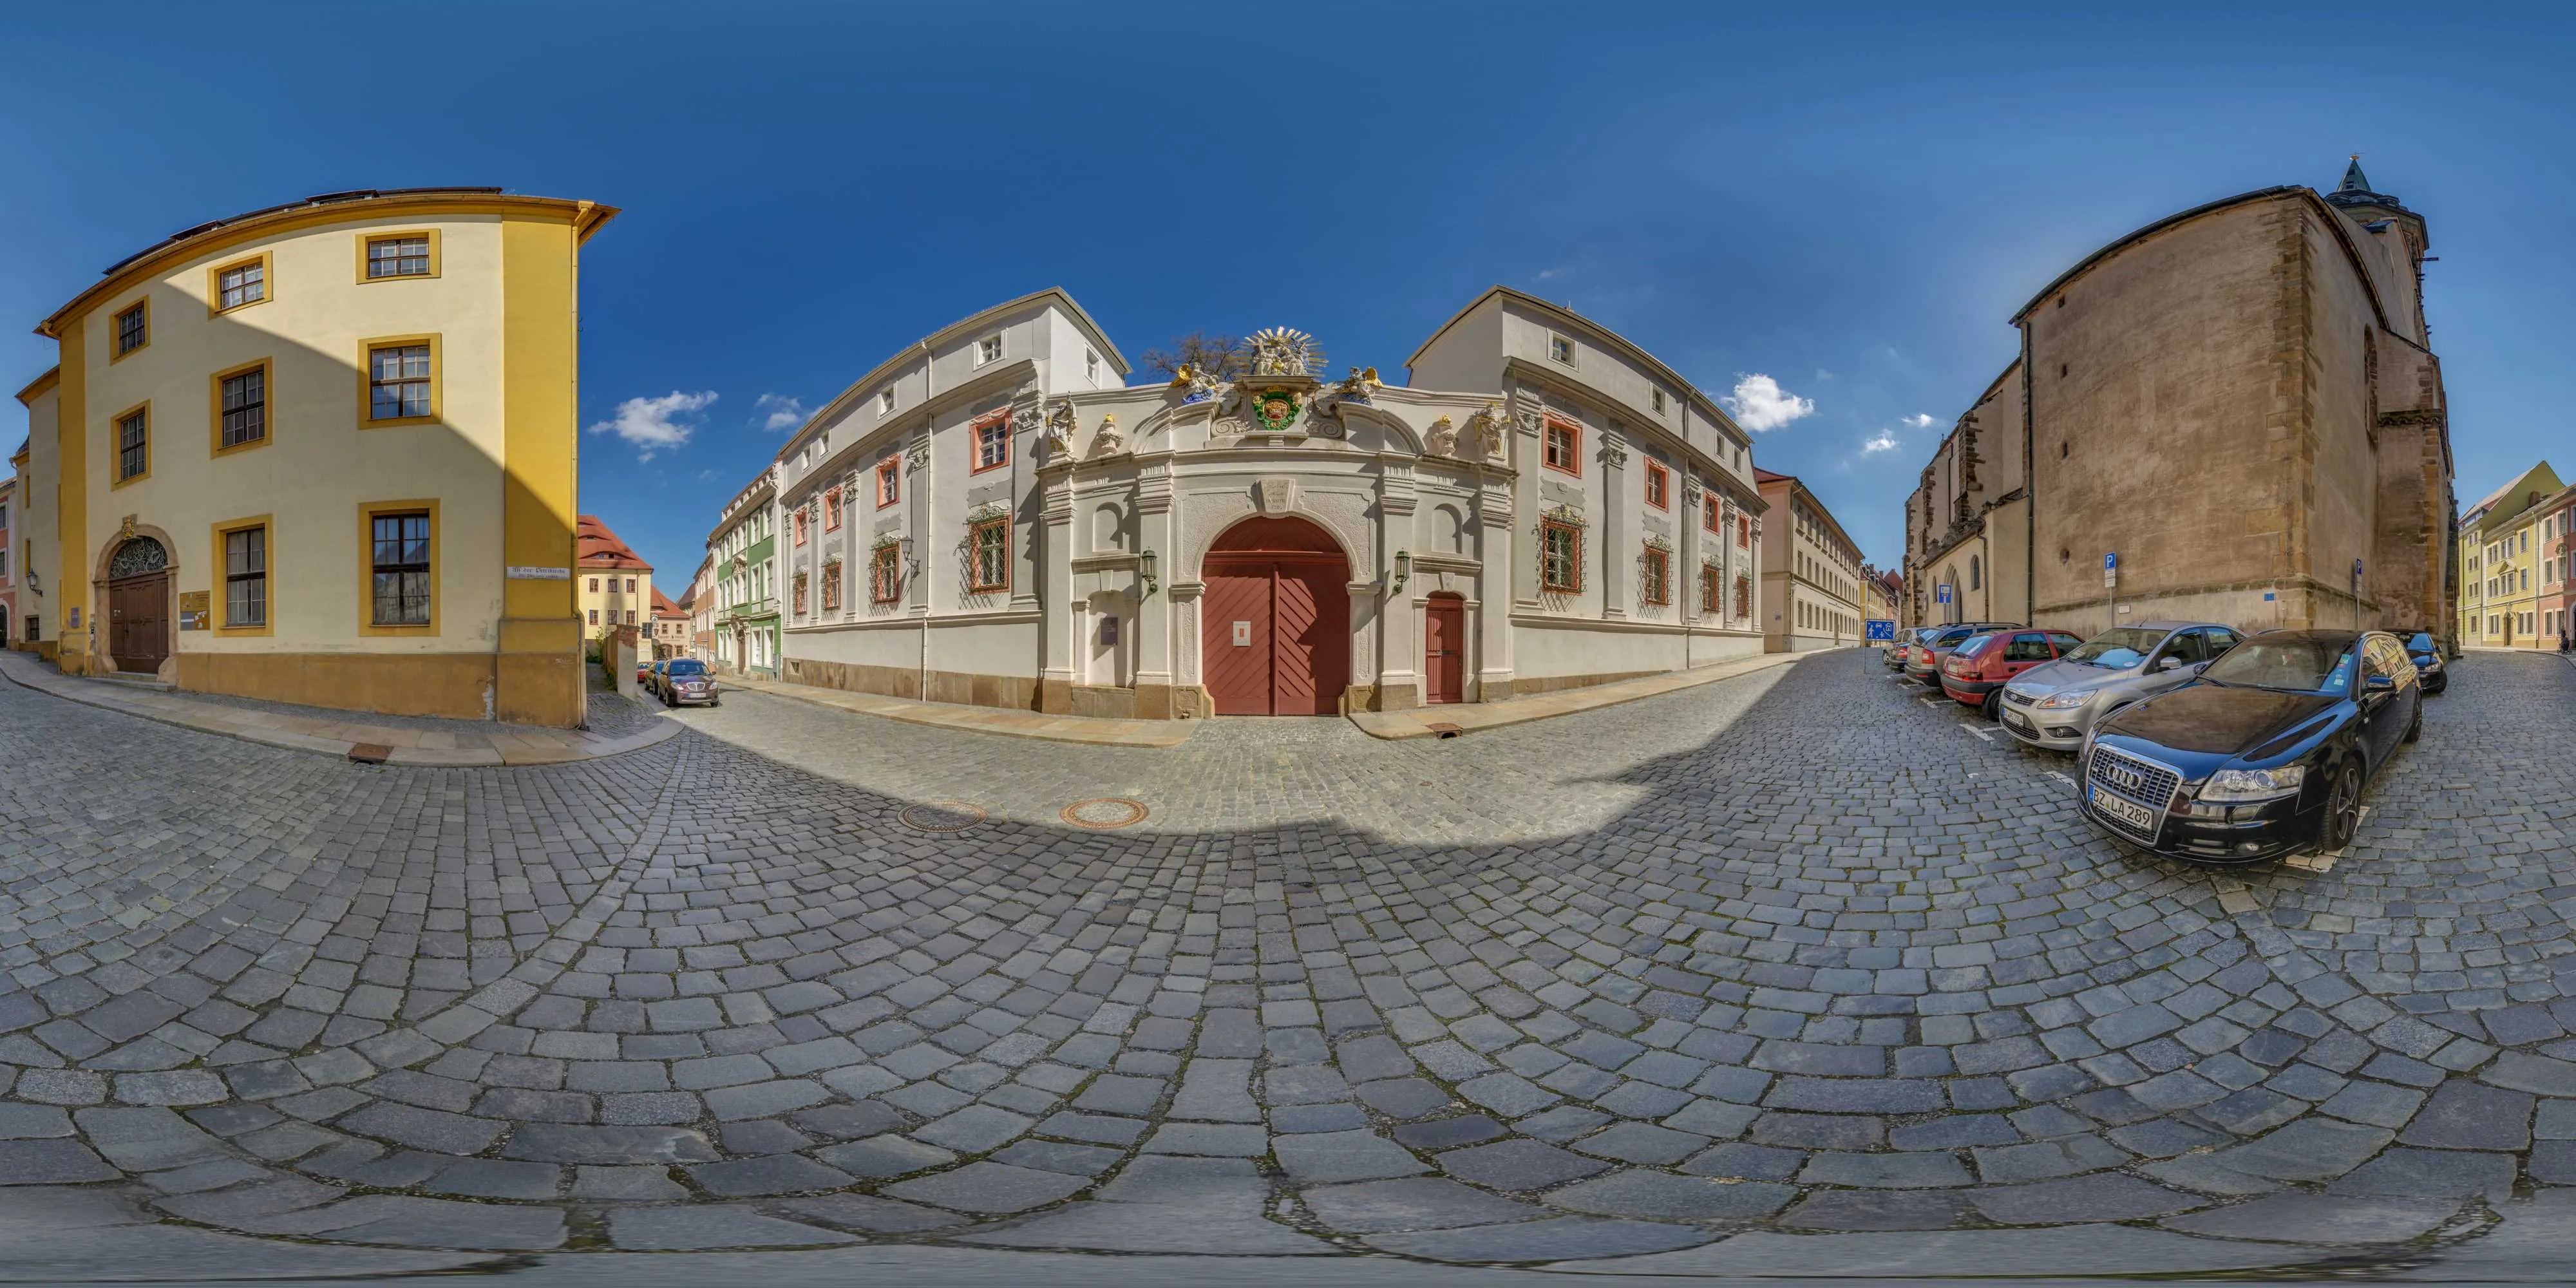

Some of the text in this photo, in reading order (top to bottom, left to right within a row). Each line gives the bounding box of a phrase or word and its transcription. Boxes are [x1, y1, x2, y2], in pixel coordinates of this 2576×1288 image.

[2107, 555, 2113, 567] P
[2094, 789, 2150, 825] BZ LA 289
